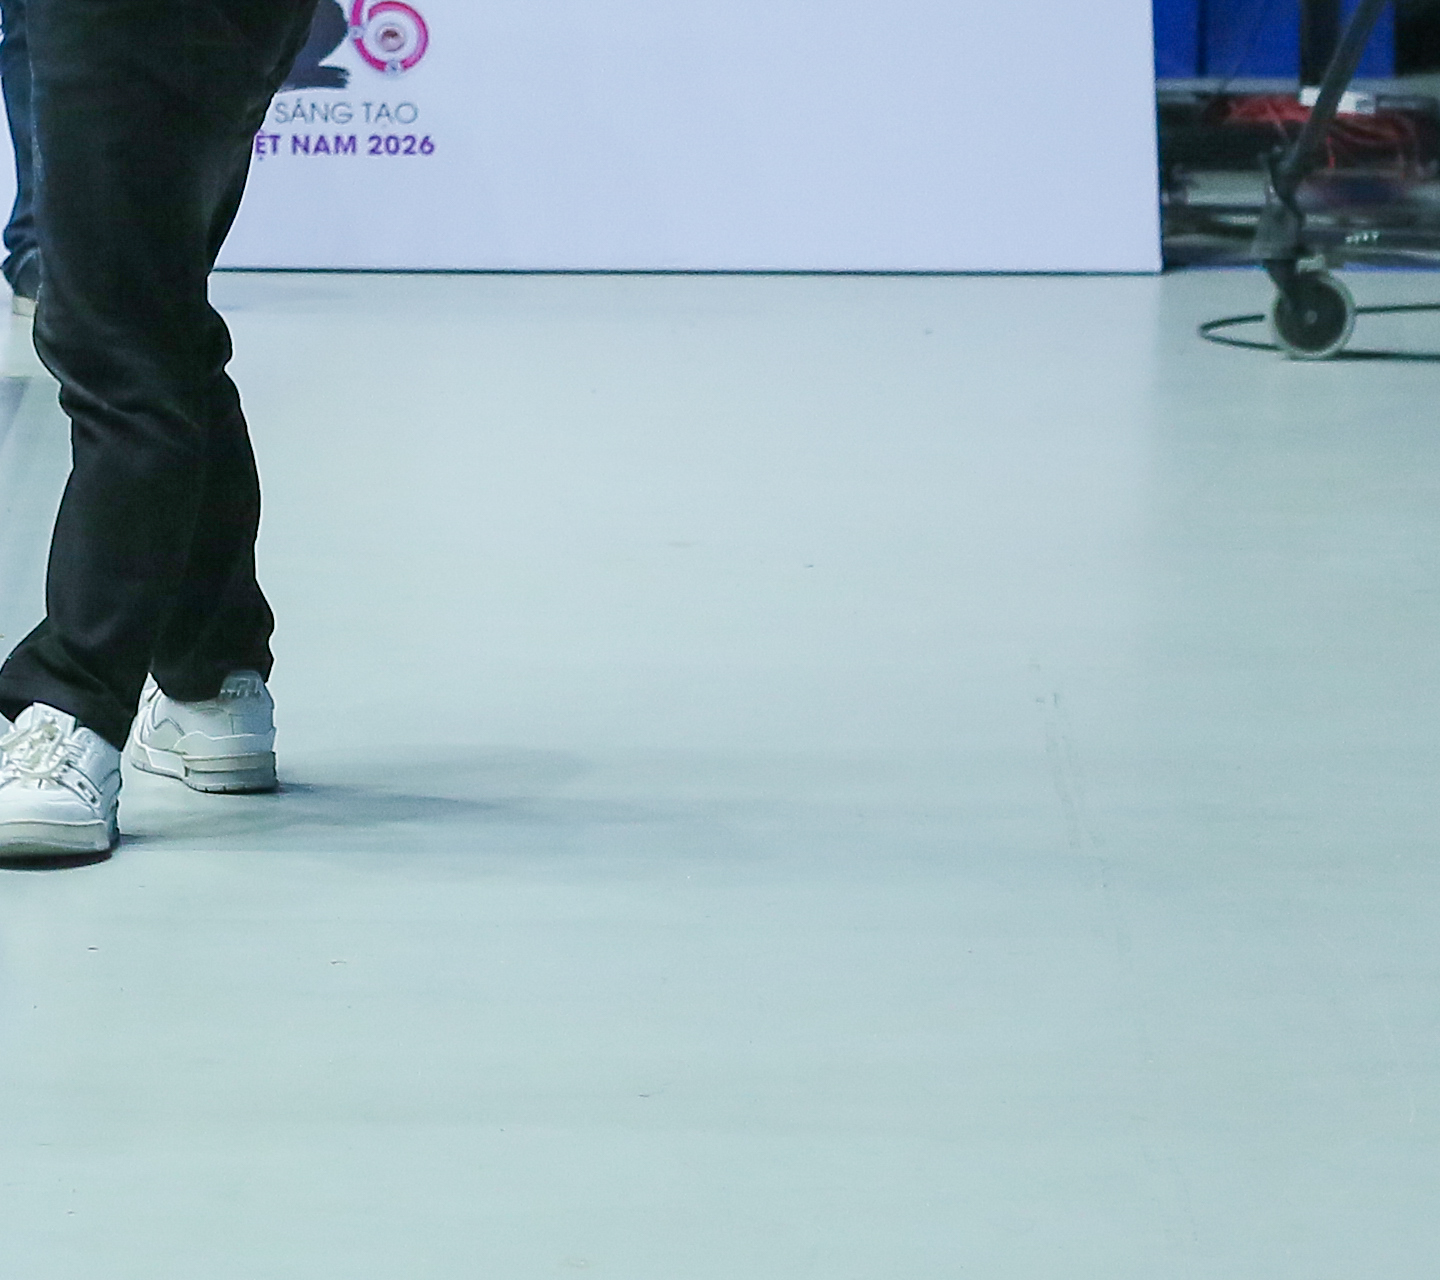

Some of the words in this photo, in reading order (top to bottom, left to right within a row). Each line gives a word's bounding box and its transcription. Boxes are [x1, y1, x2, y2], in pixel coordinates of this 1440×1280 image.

[274, 98, 354, 124] SÁNG
[361, 102, 419, 128] TẠO
[254, 129, 281, 161] ỆT
[291, 135, 357, 156] NAM
[368, 135, 435, 156] 2026
